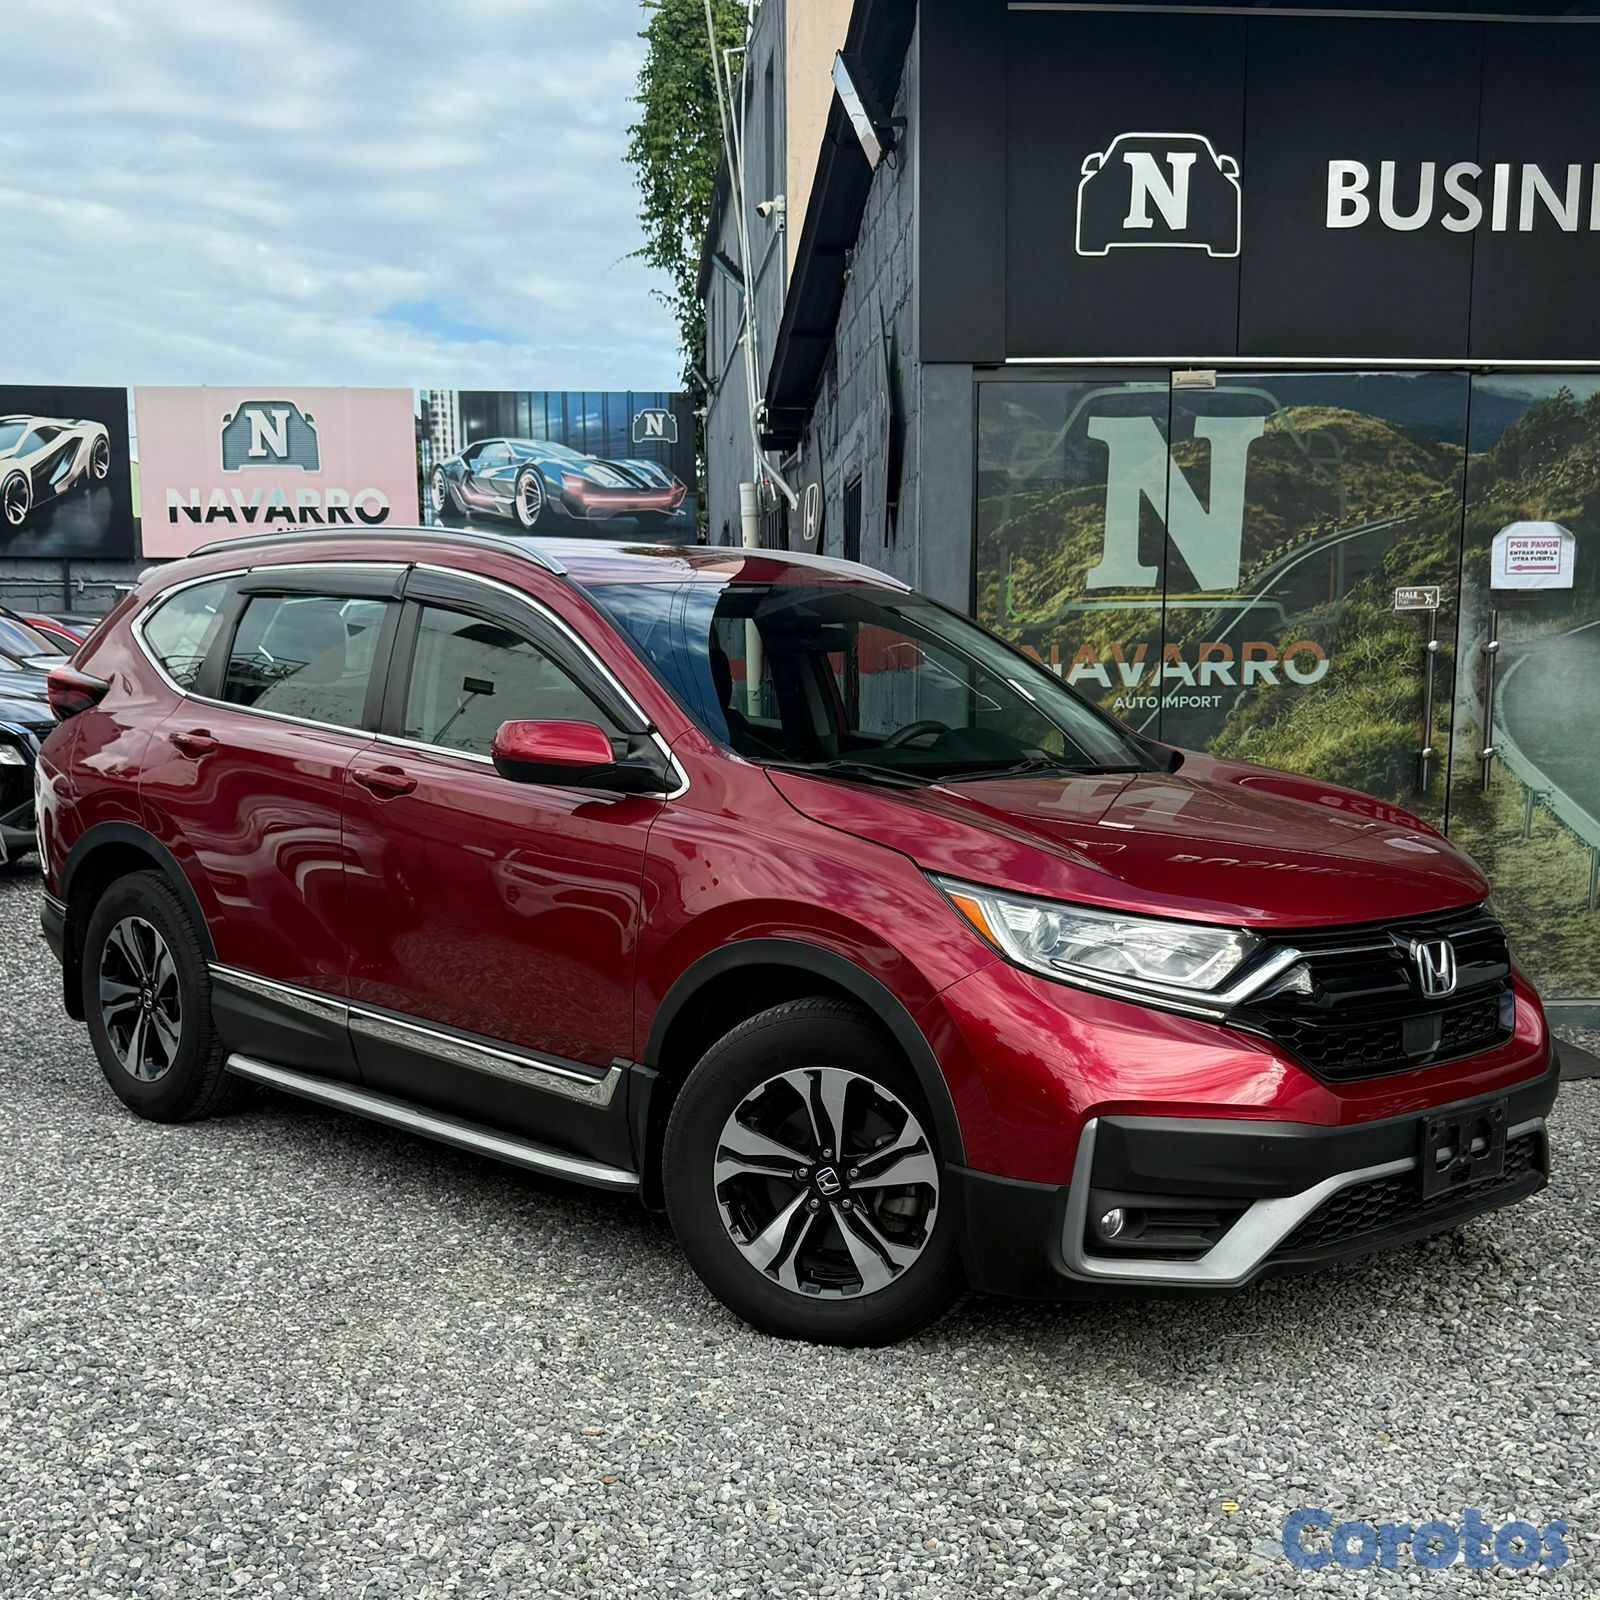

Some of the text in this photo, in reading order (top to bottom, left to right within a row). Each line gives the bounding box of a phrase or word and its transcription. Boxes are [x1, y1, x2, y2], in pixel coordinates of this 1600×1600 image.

[1123, 152, 1197, 231] N
[1326, 160, 1600, 233] BUSIN
[245, 409, 290, 458] N
[644, 413, 665, 436] N
[166, 488, 390, 525] NAVARRO
[1086, 416, 1266, 591] N
[1510, 541, 1559, 549] POR FAVOR
[1113, 695, 1222, 710] AUTO IMPORT
